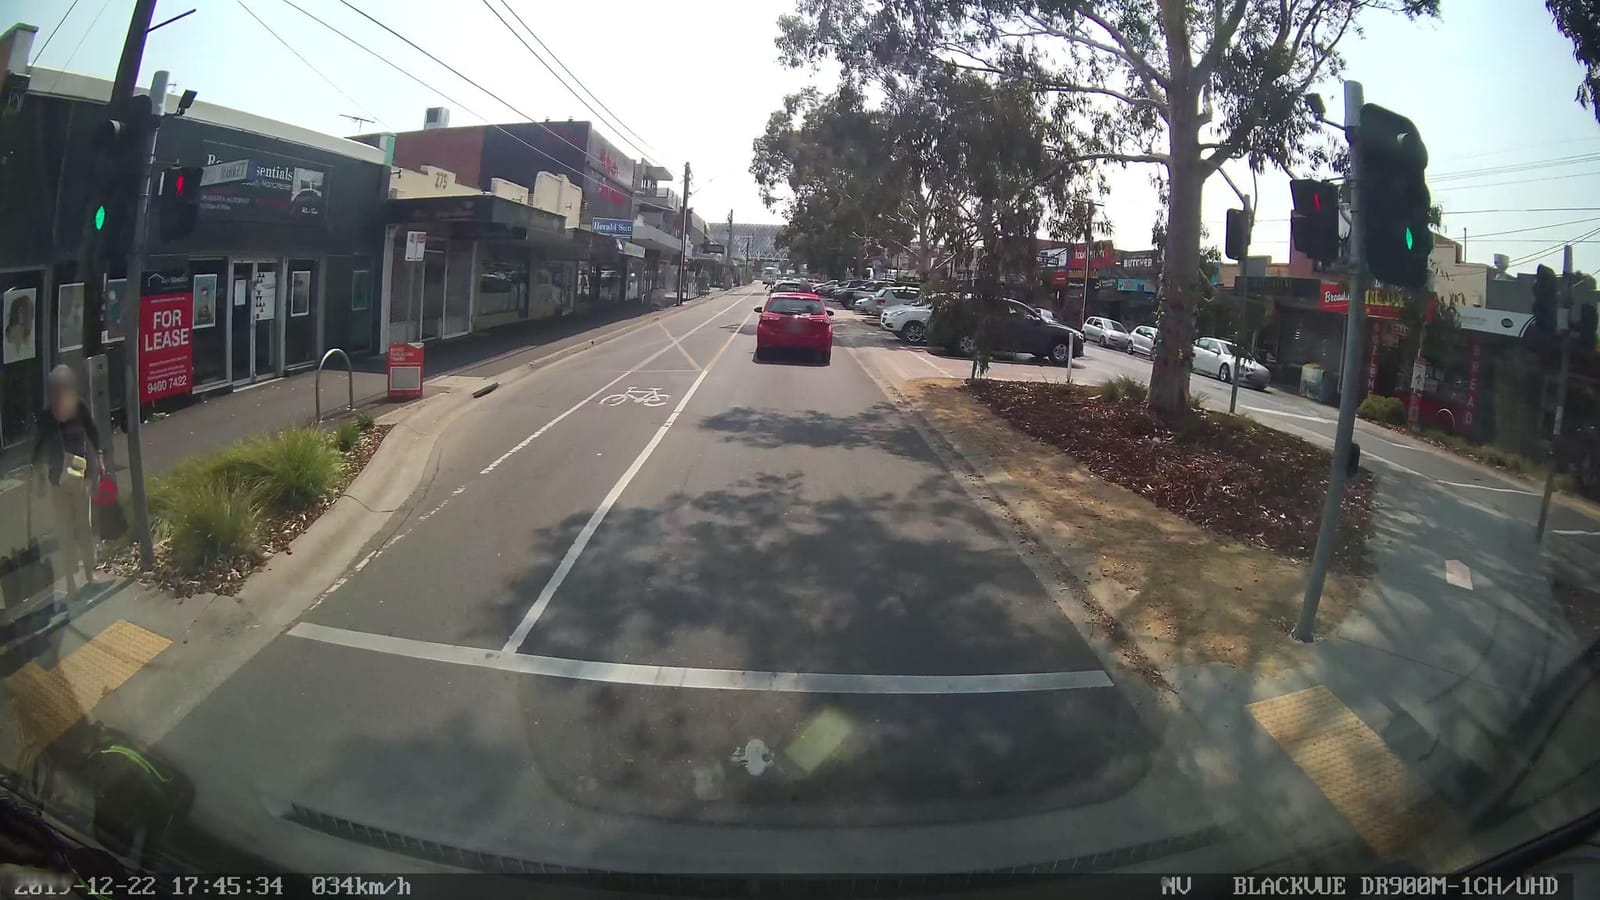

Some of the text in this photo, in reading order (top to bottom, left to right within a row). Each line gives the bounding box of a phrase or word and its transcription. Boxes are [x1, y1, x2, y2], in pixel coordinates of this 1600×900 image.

[434, 172, 448, 189] 275
[594, 221, 632, 232] Herald Sun
[1123, 258, 1153, 268] BUTCHER
[153, 309, 182, 331] FOR
[145, 328, 190, 352] LEASE
[168, 375, 187, 390] 7422
